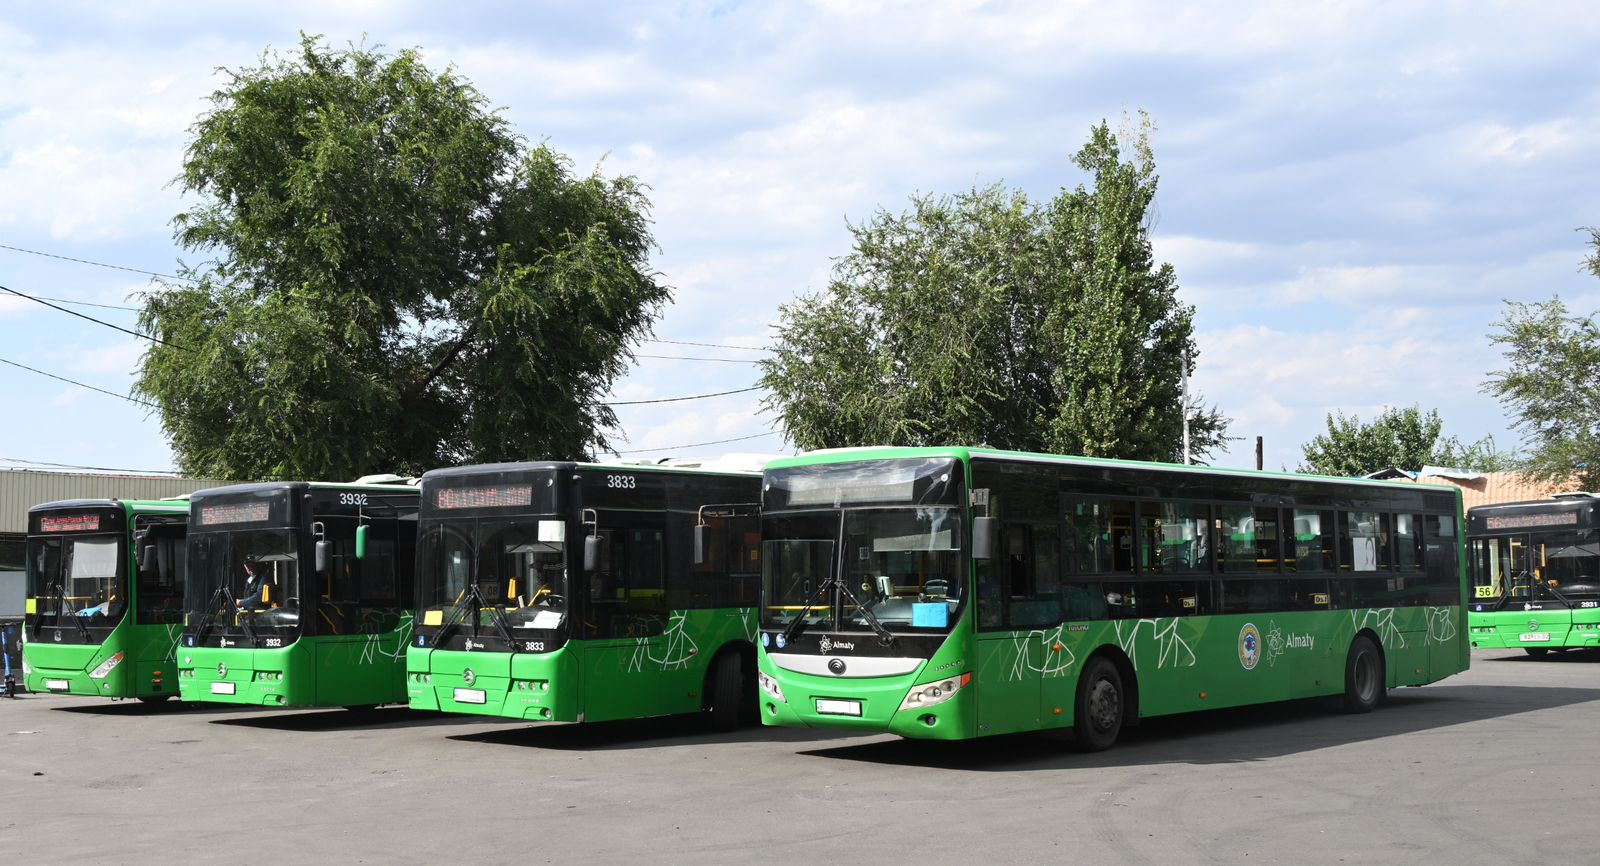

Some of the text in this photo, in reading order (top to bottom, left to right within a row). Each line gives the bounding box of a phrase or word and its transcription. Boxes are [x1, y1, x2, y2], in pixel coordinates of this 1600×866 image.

[607, 474, 636, 489] 3833
[339, 492, 368, 505] 3932
[1479, 587, 1491, 597] 56
[266, 638, 281, 647] 3932
[525, 641, 545, 651] 3833
[832, 641, 855, 651] Almaty
[1286, 632, 1315, 650] Almaty
